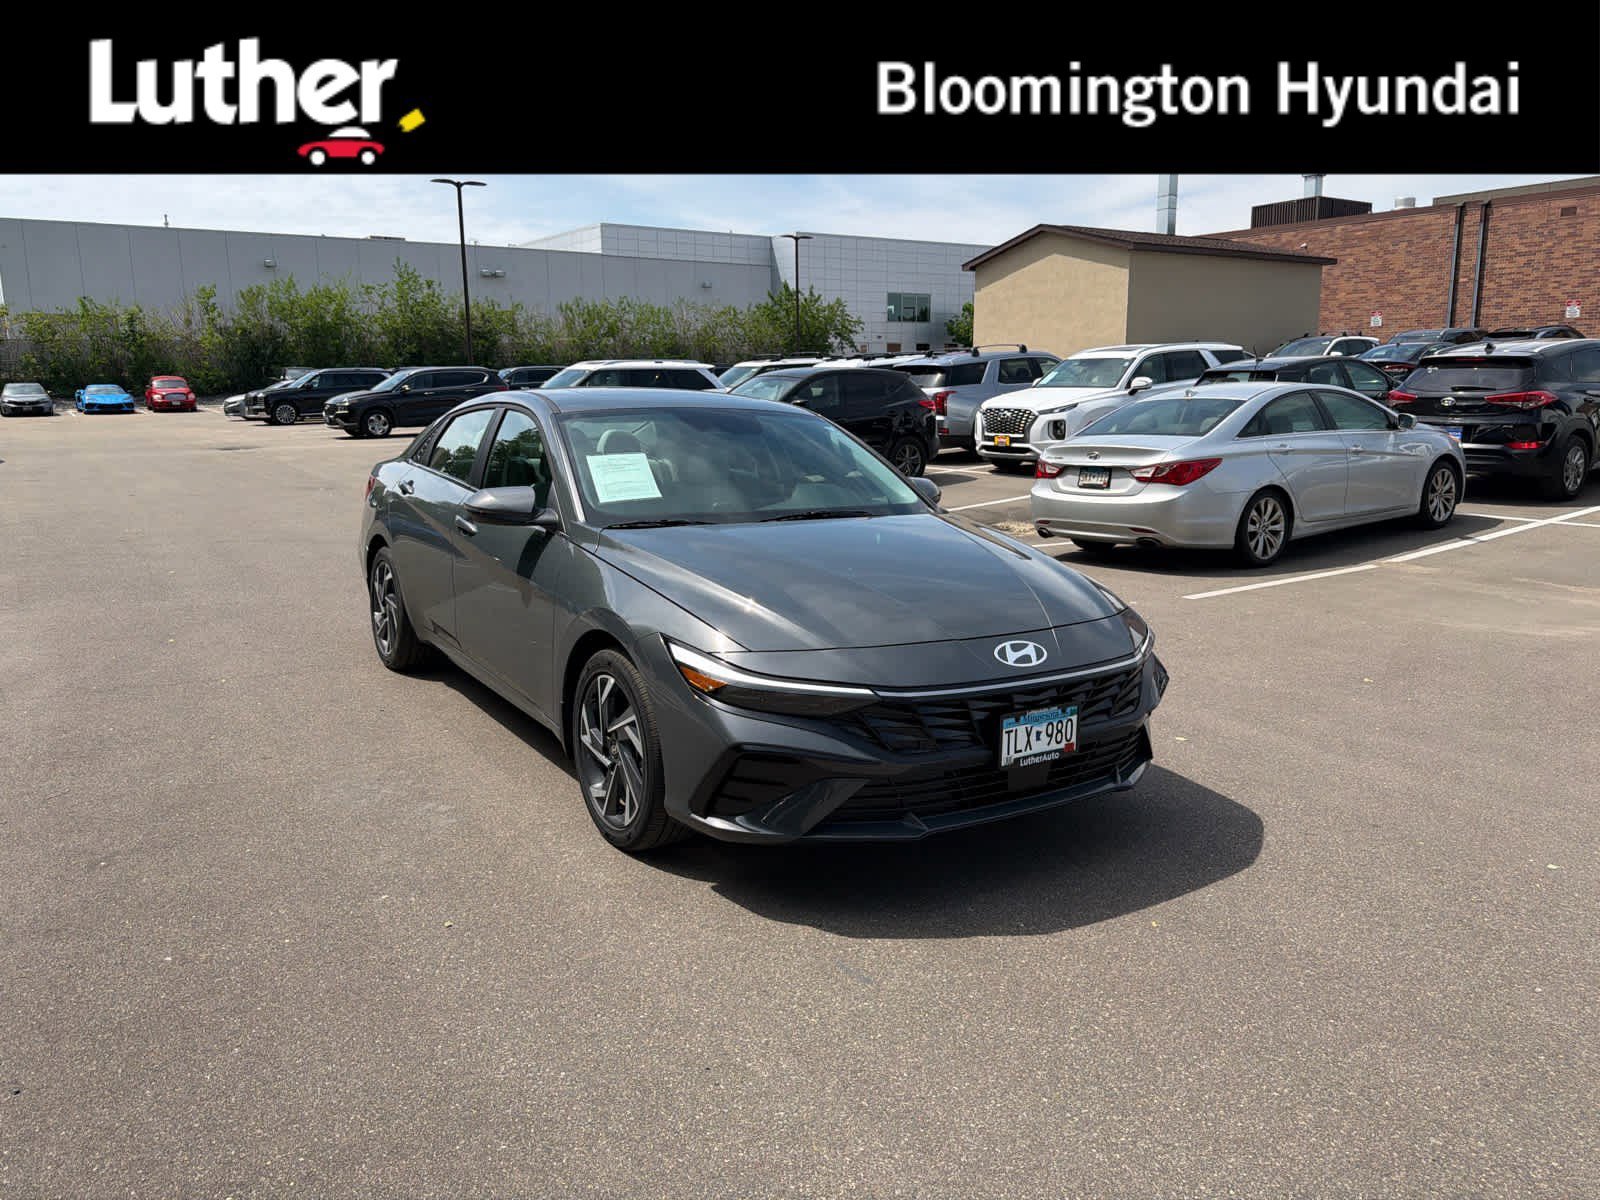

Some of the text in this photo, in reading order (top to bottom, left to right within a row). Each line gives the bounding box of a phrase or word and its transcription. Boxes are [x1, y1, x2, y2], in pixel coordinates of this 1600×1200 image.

[1005, 718, 1073, 755] TLX 980
[1020, 752, 1060, 767] LutherAuto
